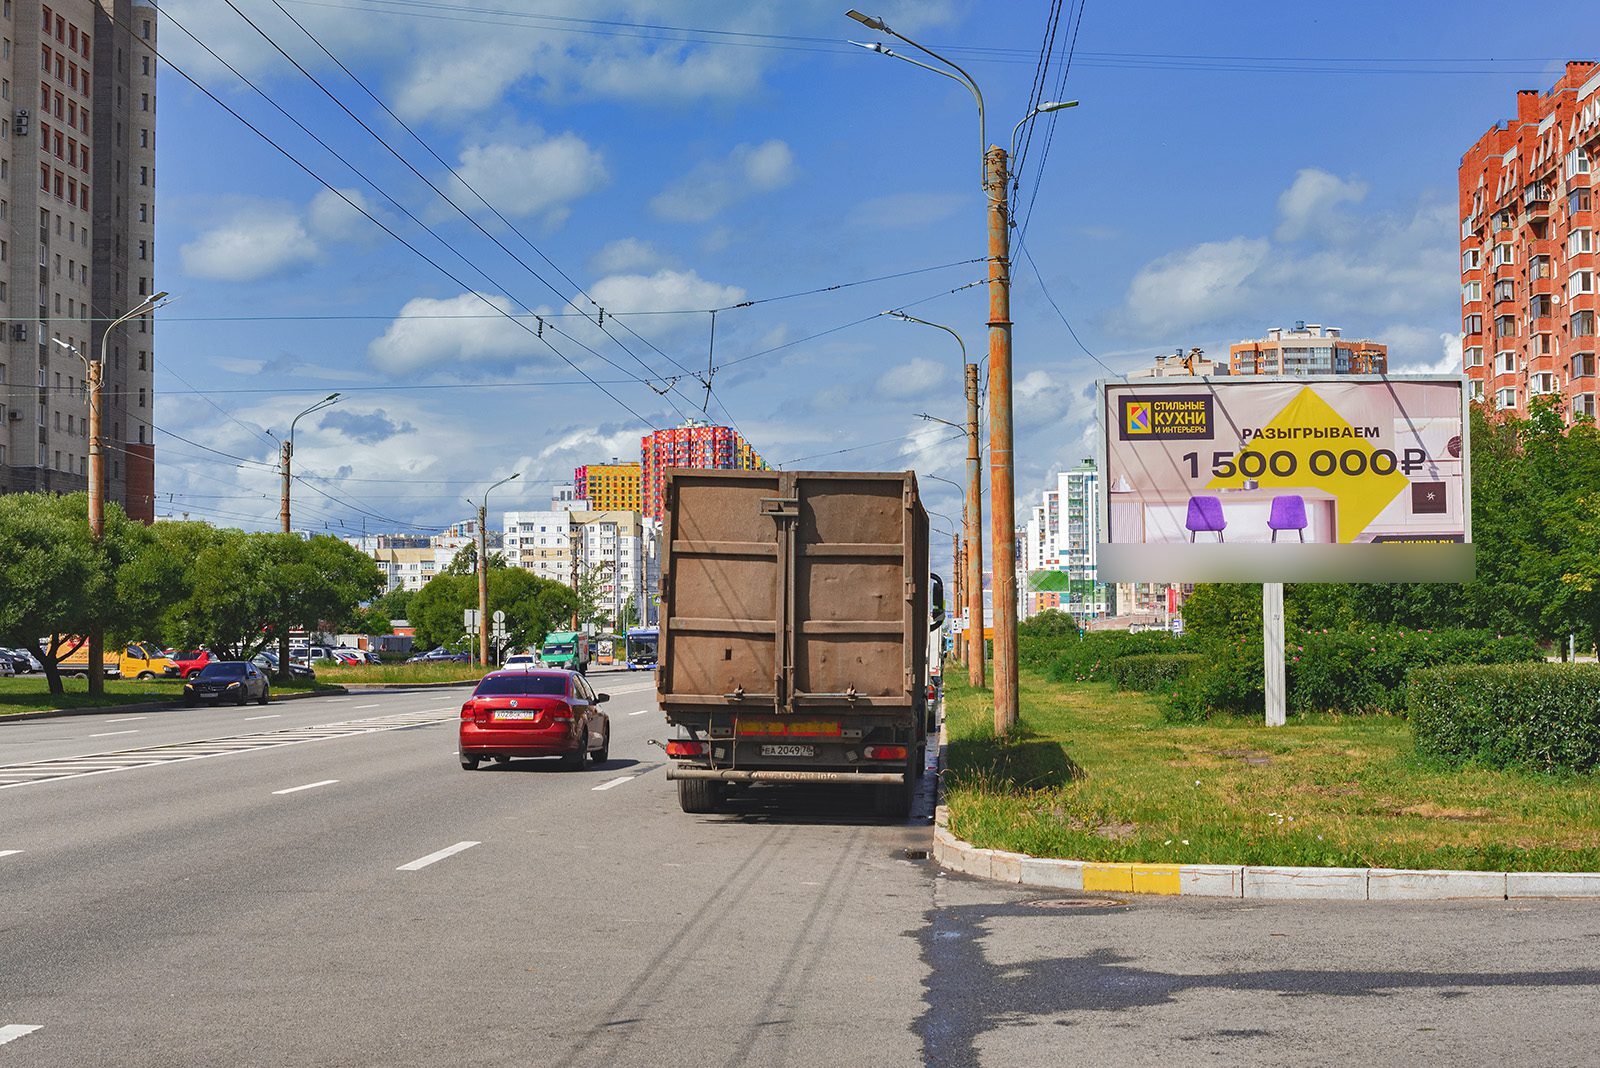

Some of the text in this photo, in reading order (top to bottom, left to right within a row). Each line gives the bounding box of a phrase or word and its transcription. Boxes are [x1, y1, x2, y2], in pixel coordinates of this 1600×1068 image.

[1154, 401, 1205, 410] СТИЛЬНЫЕ
[1154, 412, 1206, 425] КУХНИ
[1243, 427, 1380, 439] РАЗЫГРЫВАЕМ
[1183, 452, 1199, 478] 1
[1211, 450, 1298, 478] 500
